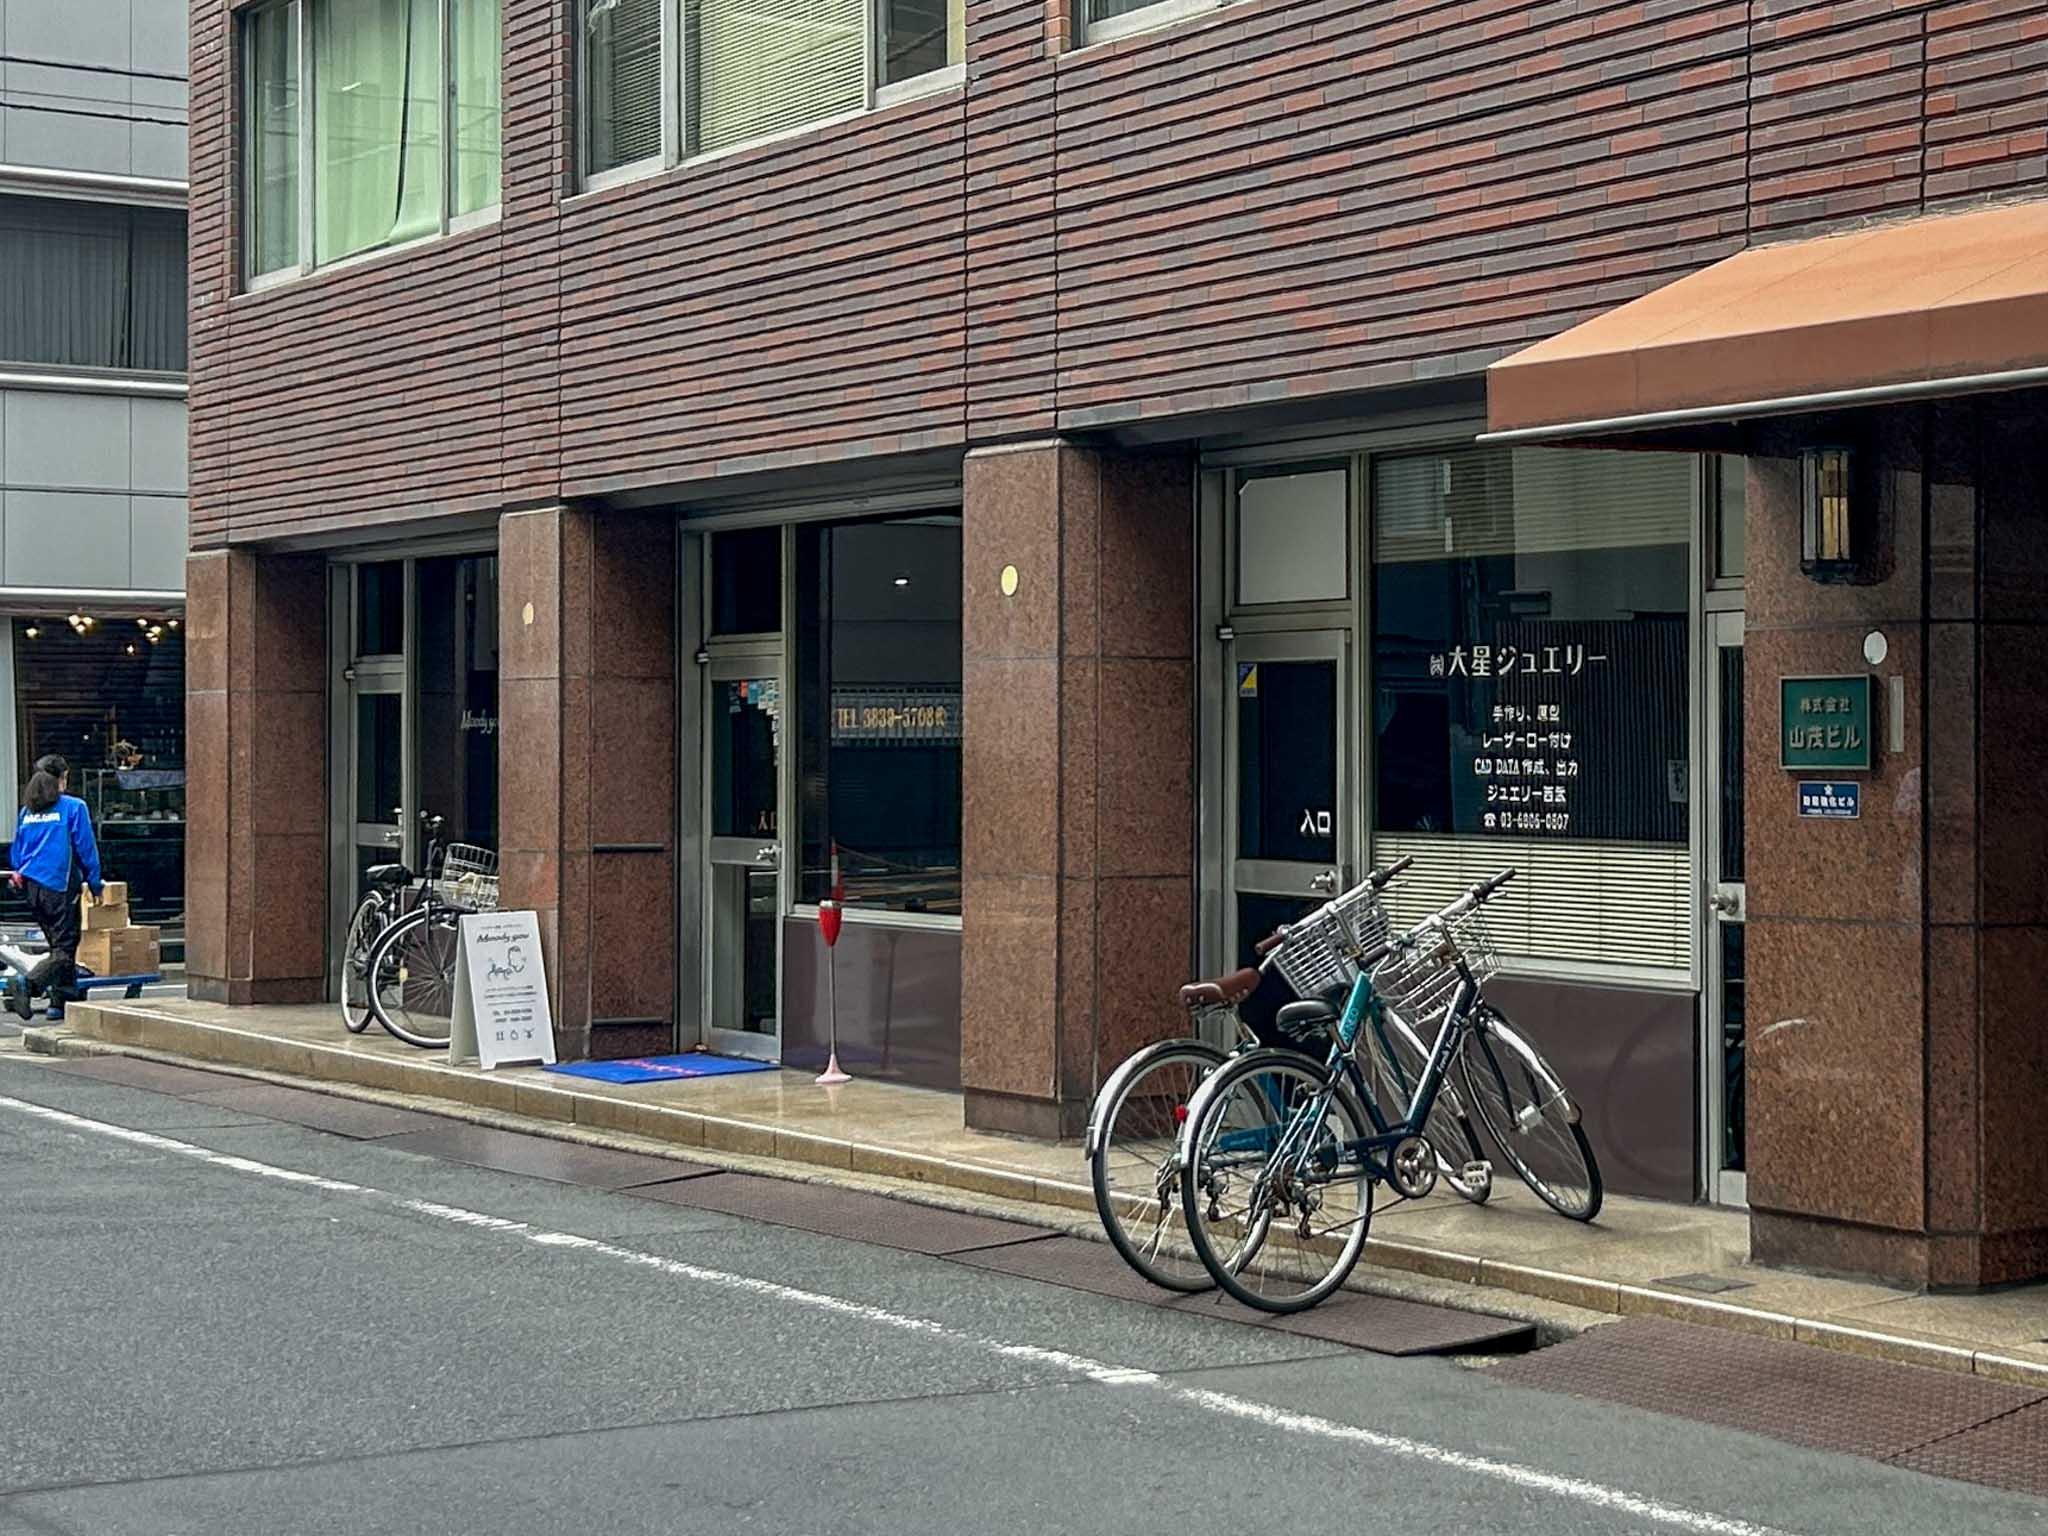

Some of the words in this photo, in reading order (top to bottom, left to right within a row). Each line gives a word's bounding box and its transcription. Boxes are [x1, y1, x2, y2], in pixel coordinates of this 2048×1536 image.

[1799, 696, 1853, 713] 株式会社
[837, 707, 858, 729] TEL
[1789, 725, 1861, 749] 山茂ビル
[1474, 757, 1492, 775] CAD
[1495, 758, 1520, 775] DATA
[1300, 808, 1331, 835] 入口
